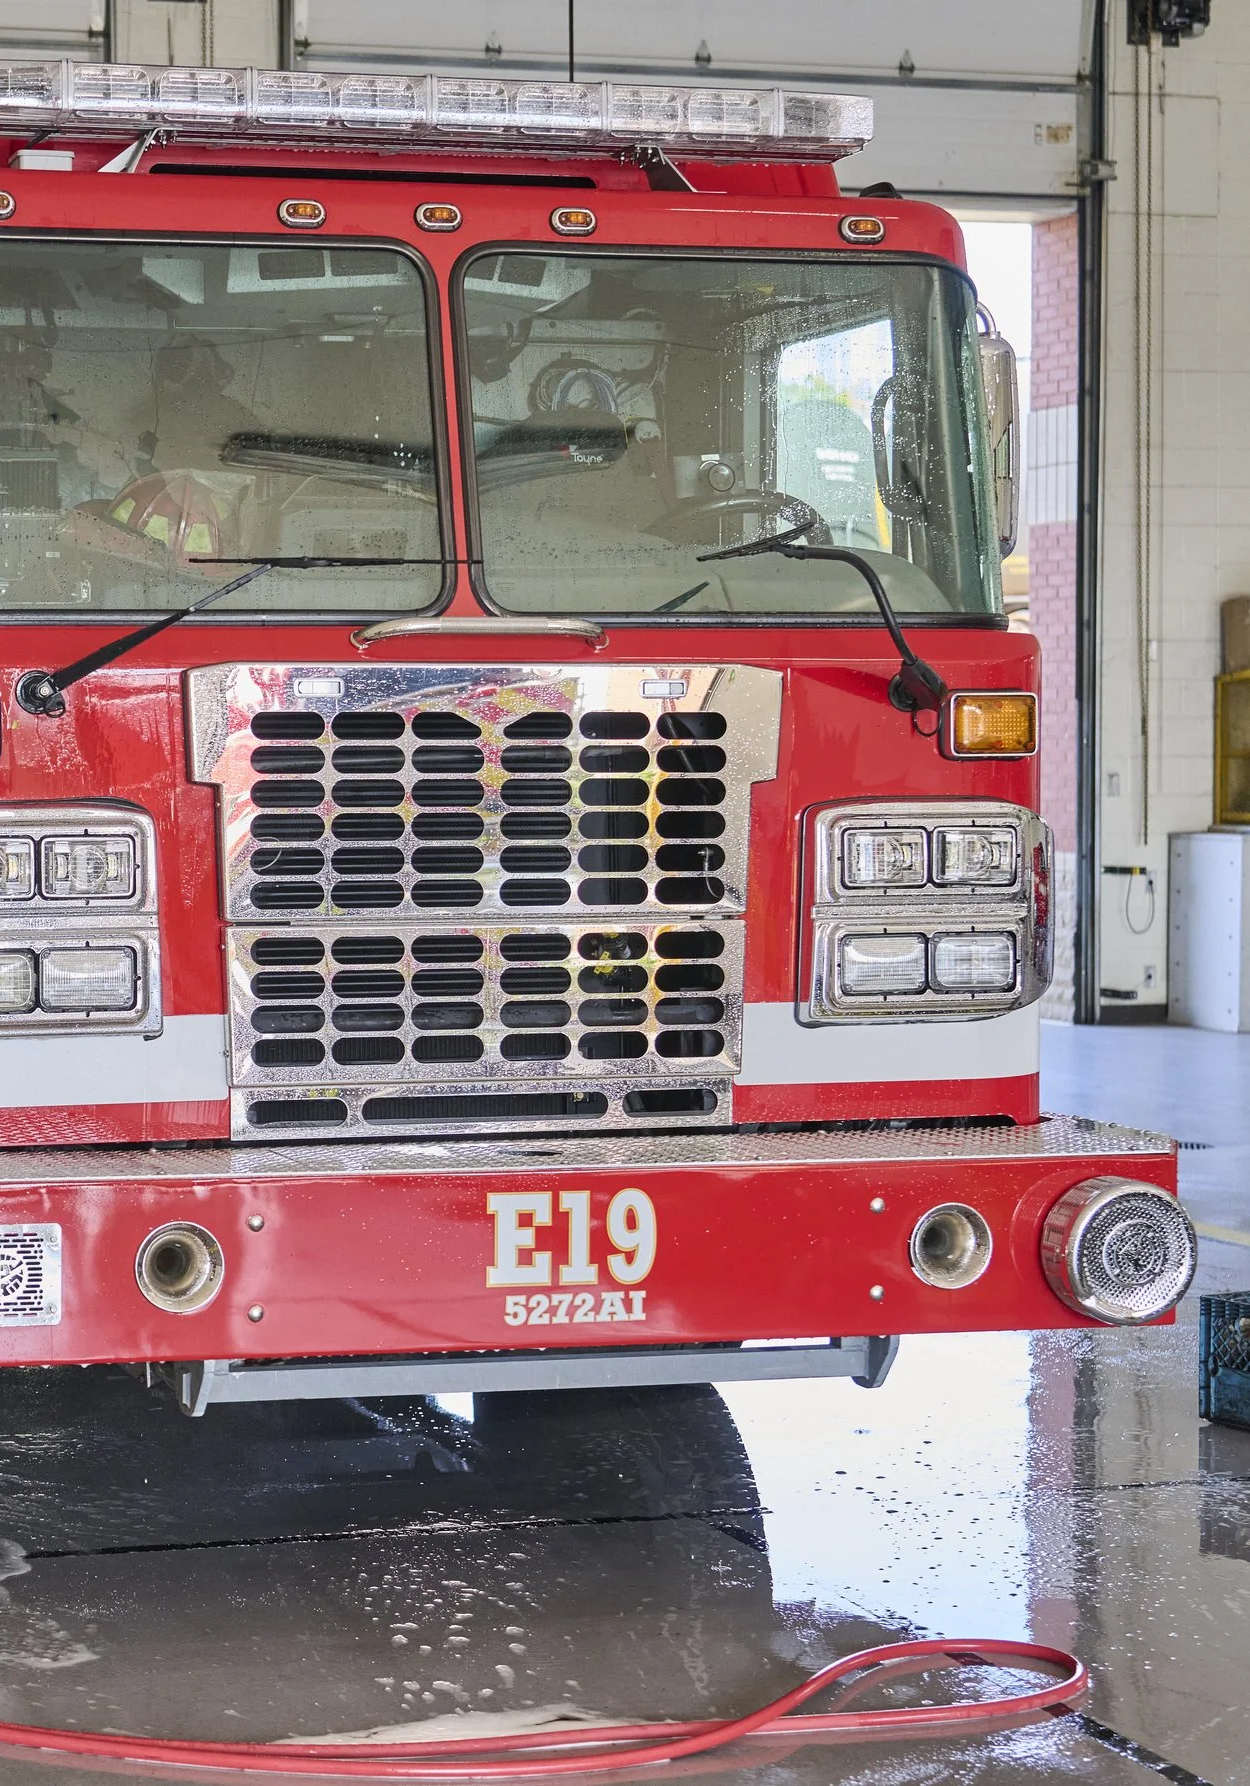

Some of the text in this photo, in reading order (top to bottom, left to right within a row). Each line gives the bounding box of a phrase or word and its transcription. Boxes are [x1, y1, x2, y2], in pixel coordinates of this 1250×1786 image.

[570, 452, 604, 466] Toyne
[486, 1188, 657, 1288] E19
[504, 1290, 647, 1326] 5272AI
